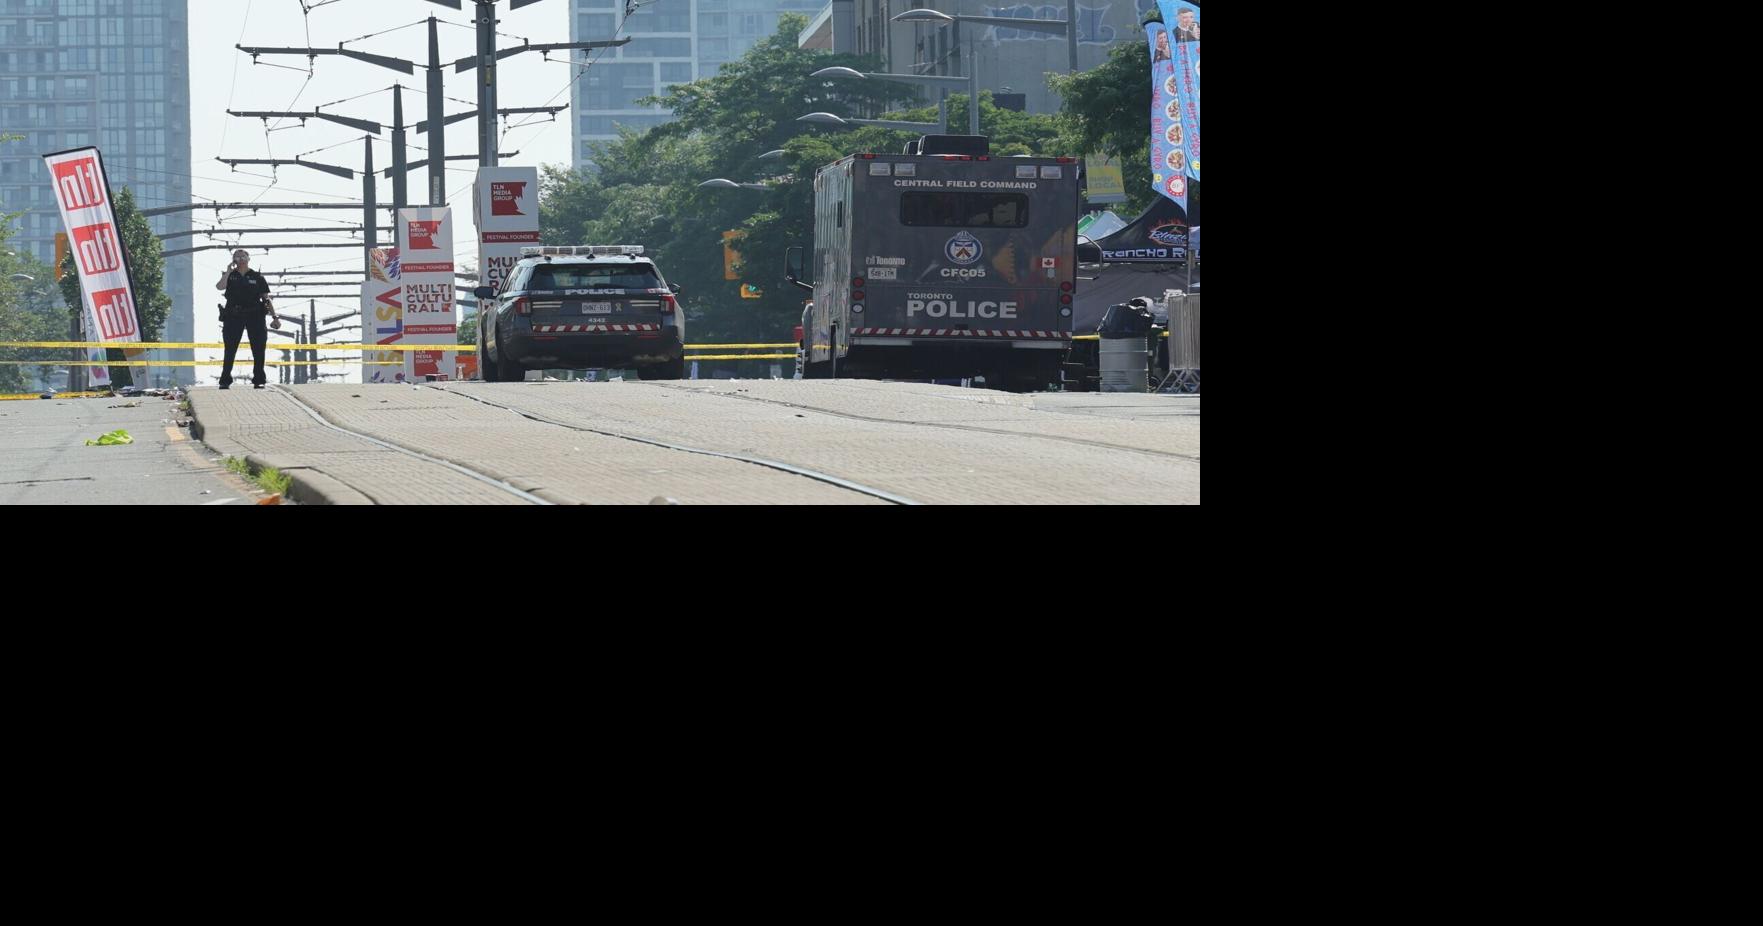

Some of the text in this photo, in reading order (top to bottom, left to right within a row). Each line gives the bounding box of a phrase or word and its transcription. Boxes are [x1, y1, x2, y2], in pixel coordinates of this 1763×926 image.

[894, 179, 1037, 189] CENTRAL FIELD COMMAND
[940, 268, 986, 277] CFC05
[406, 284, 452, 294] MULTI
[406, 293, 453, 304] CULTU
[907, 292, 953, 300] TORONTO
[407, 303, 440, 314] RAL
[907, 300, 1017, 318] POLICE
